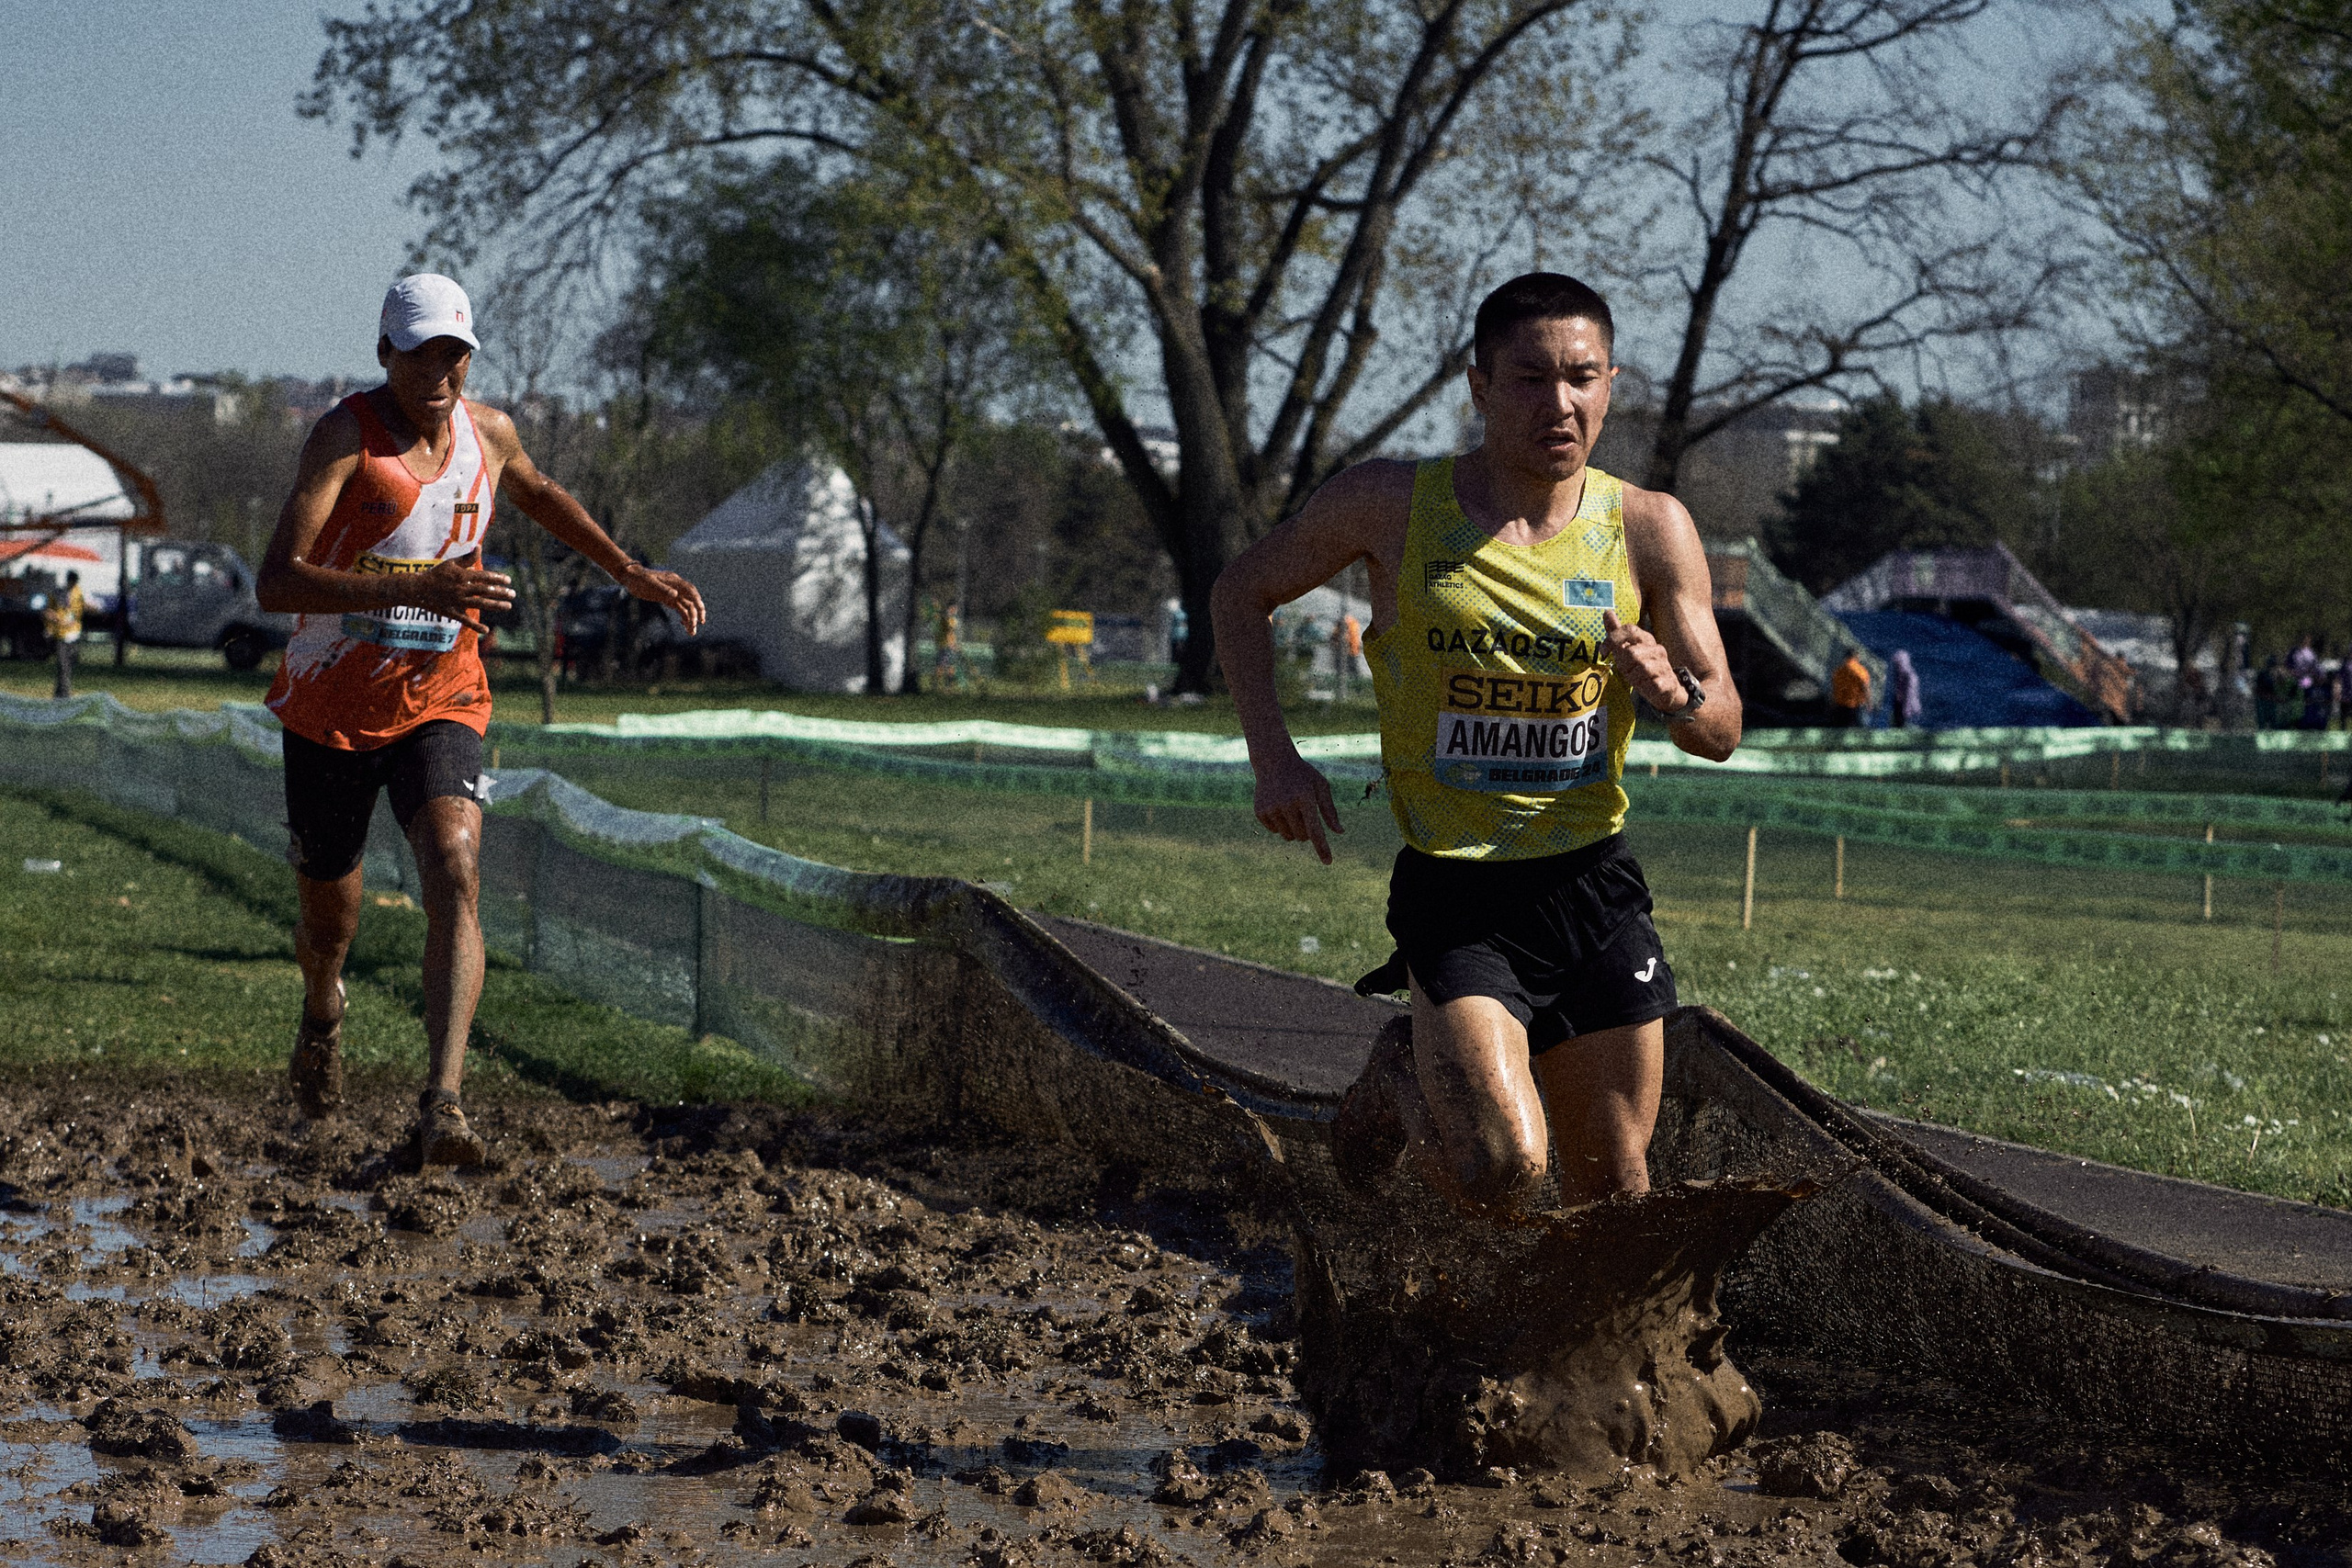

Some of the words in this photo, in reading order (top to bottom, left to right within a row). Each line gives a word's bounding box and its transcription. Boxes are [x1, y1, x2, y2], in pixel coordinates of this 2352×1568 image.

[379, 627, 447, 644] BELGRADE
[1447, 672, 1602, 714] SEIKO
[1445, 715, 1601, 758] AMANGOS
[1488, 766, 1581, 783] BELGRADE
[1581, 761, 1601, 777] 24
